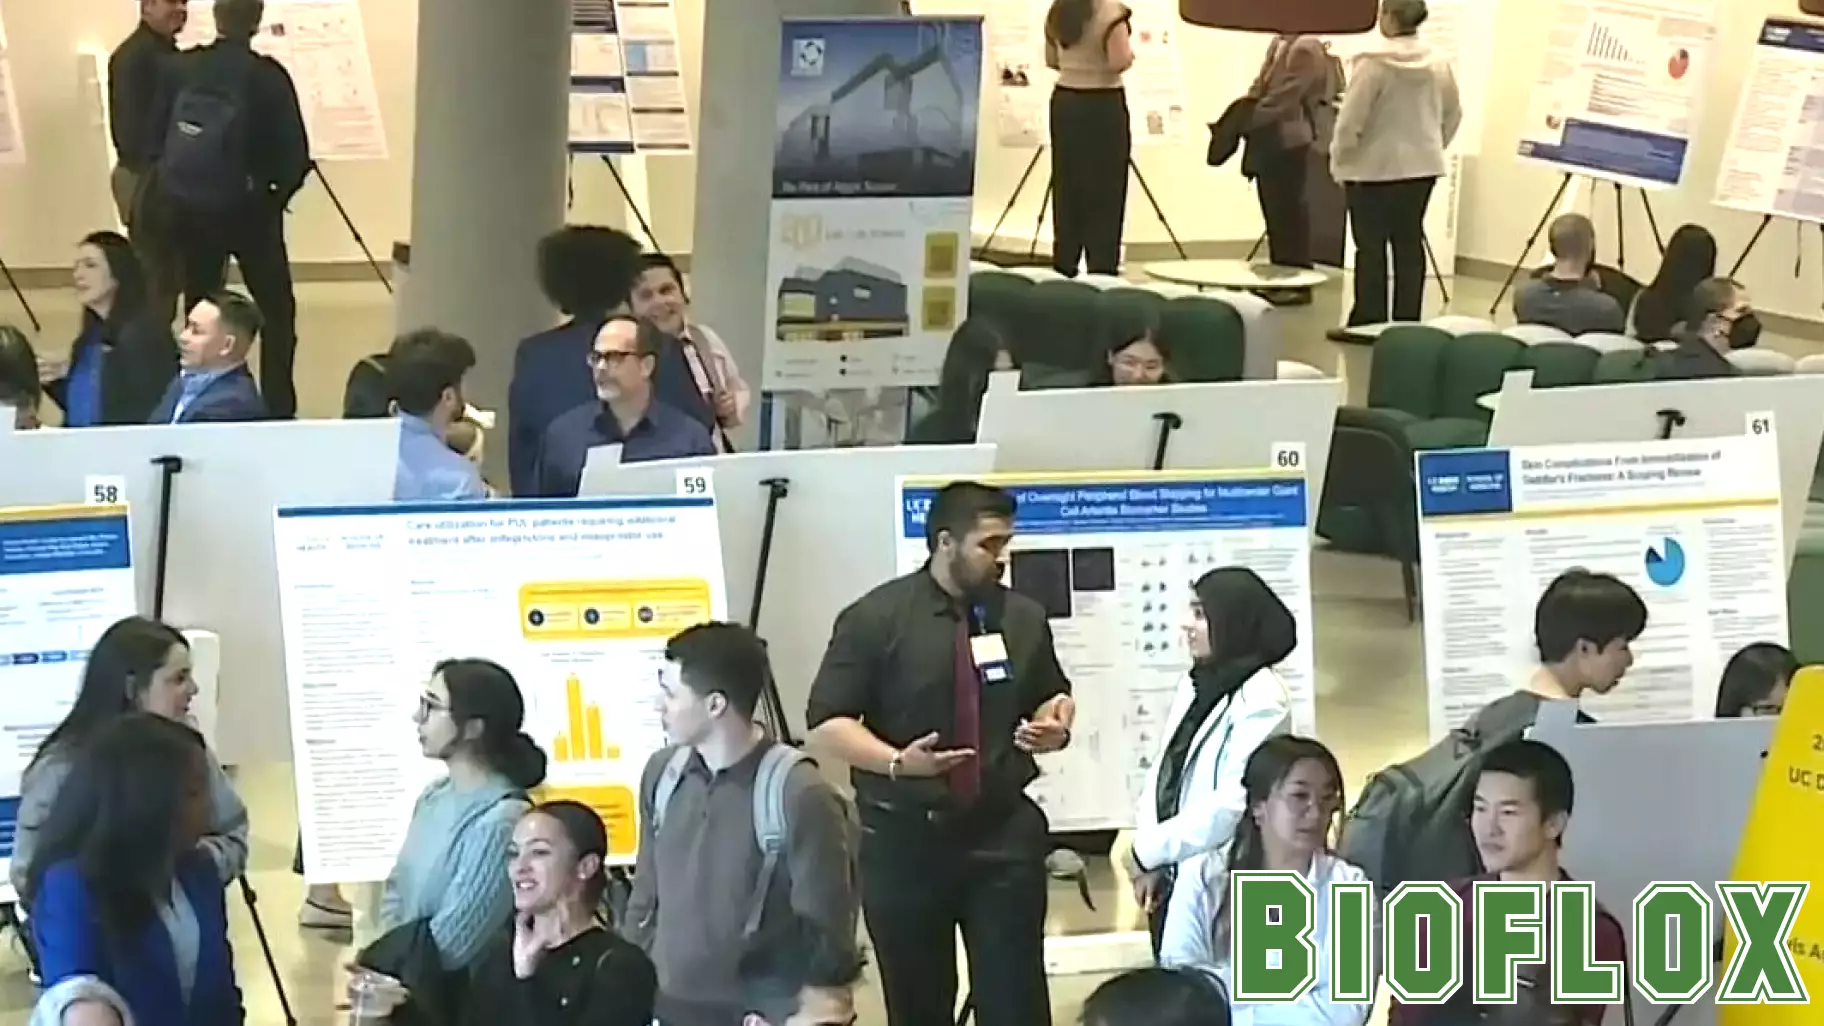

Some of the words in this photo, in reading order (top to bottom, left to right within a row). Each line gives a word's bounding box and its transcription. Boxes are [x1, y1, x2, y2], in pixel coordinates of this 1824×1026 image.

[1752, 419, 1770, 434] 61
[1277, 451, 1299, 467] 60
[1618, 470, 1626, 480] A
[93, 484, 118, 503] 58
[684, 477, 707, 495] 59
[1788, 764, 1813, 787] UC
